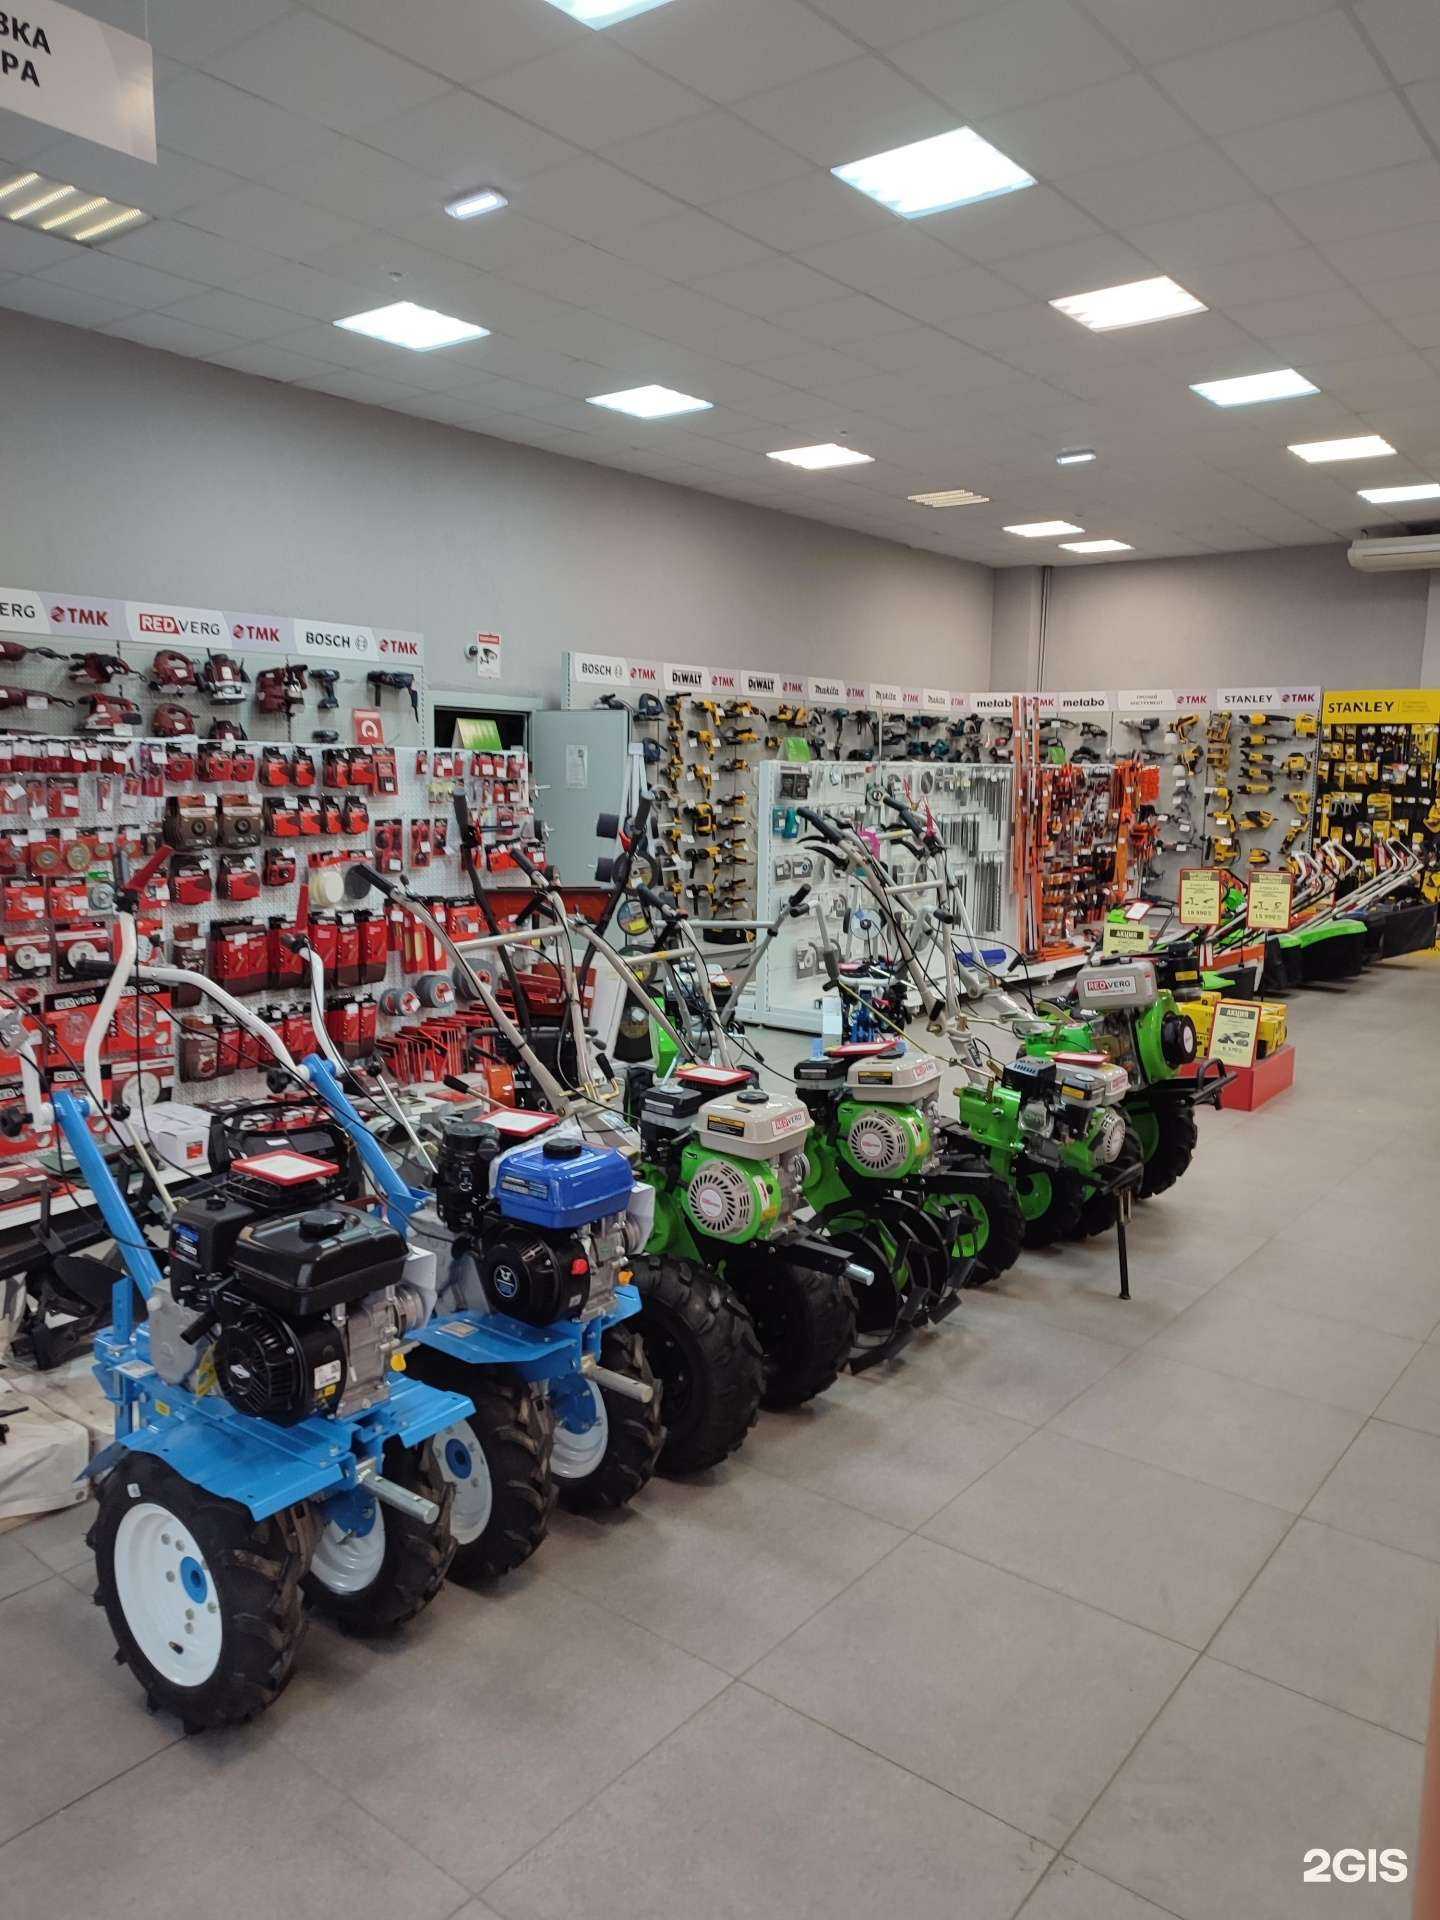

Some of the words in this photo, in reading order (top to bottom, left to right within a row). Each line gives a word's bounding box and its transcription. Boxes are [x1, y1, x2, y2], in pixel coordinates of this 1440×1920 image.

[306, 631, 351, 649] BOSCH
[582, 662, 611, 676] BOSCH
[976, 699, 1012, 708] metab
[1063, 697, 1105, 707] metabo
[1224, 695, 1273, 704] STANLEY
[1328, 702, 1394, 713] STANLEY
